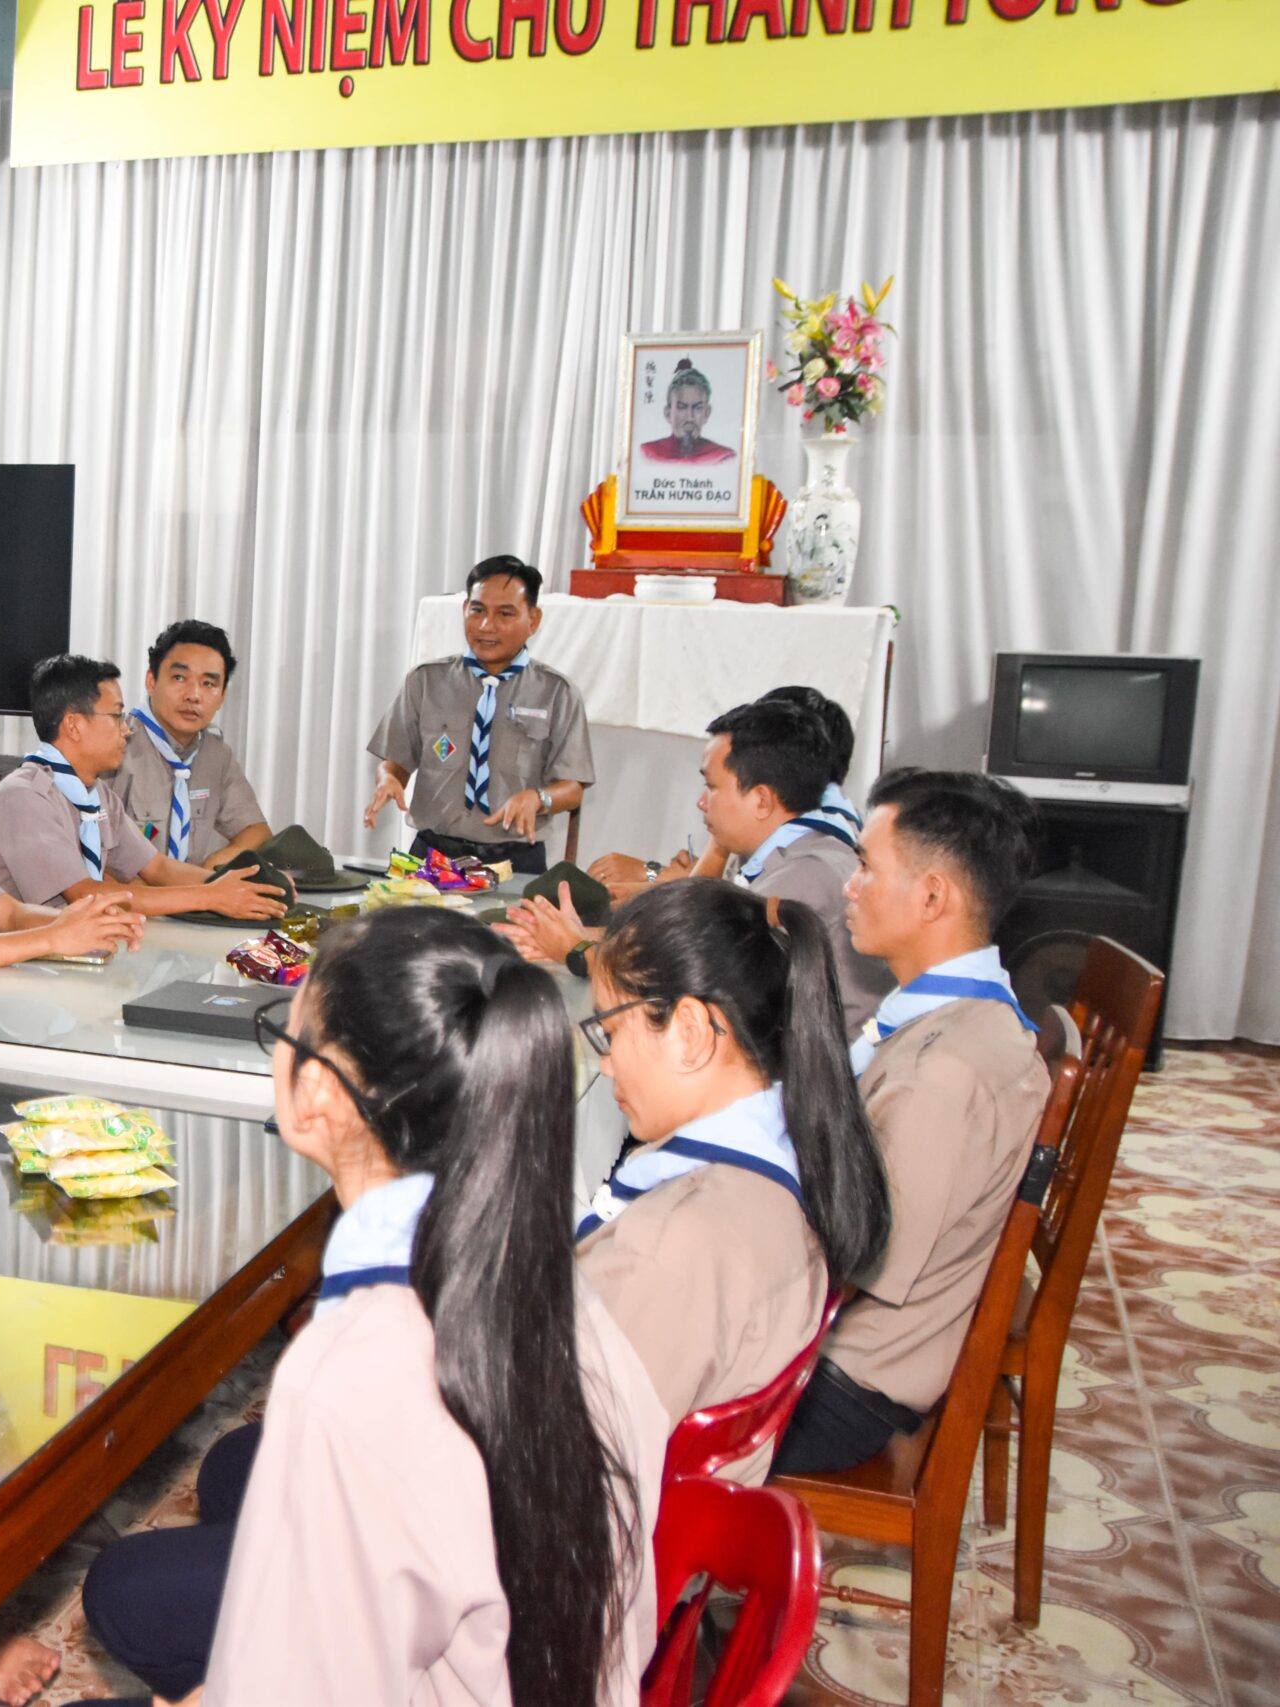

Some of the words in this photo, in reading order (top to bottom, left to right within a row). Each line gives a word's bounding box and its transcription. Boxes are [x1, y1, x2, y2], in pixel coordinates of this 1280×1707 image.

[653, 477, 676, 489] Đức
[679, 478, 714, 489] Thánh
[668, 489, 703, 501] HƯNG
[706, 490, 732, 503] ĐẠO
